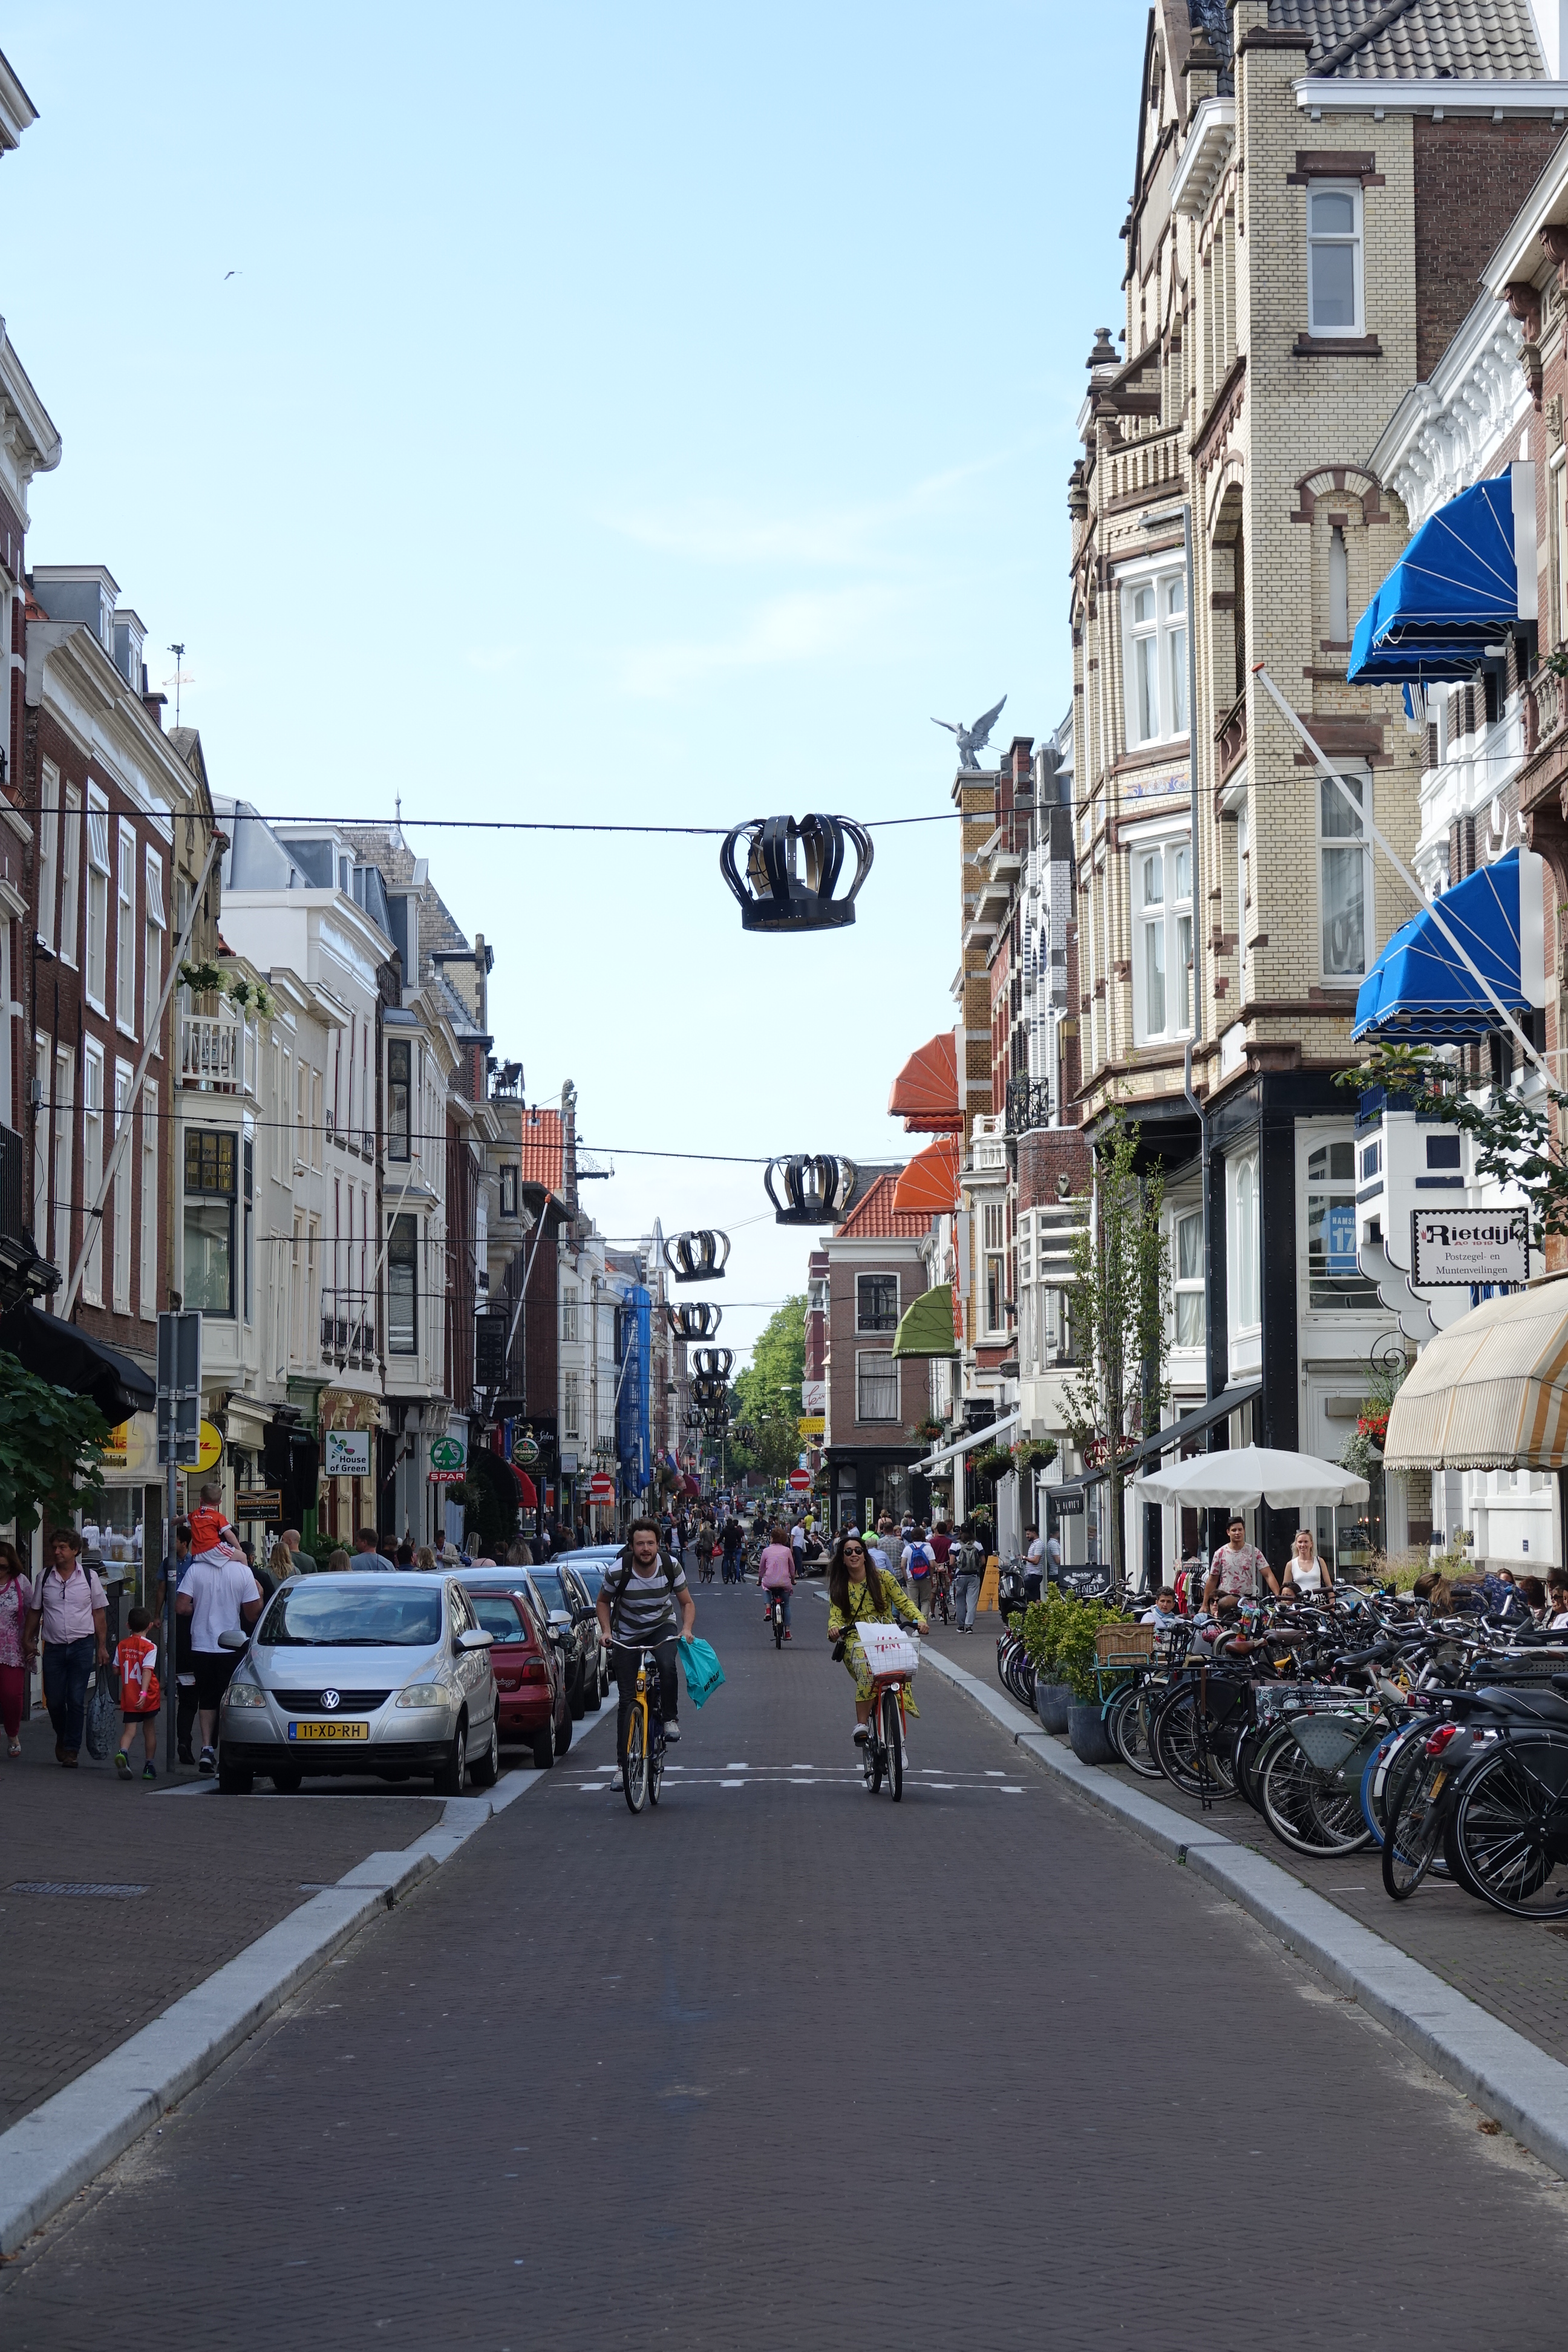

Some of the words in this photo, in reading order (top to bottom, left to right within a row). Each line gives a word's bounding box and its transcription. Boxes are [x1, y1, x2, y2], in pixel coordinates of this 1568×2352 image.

[1333, 1227, 1356, 1252] 17
[1426, 1225, 1521, 1246] Rietdijk
[1445, 1252, 1486, 1263] Postzegel-
[1436, 1266, 1508, 1276] Muntenveilingen
[123, 1660, 142, 1685] 14
[496, 1678, 516, 1688] wingo
[303, 1725, 360, 1737] 11-XD-RH
